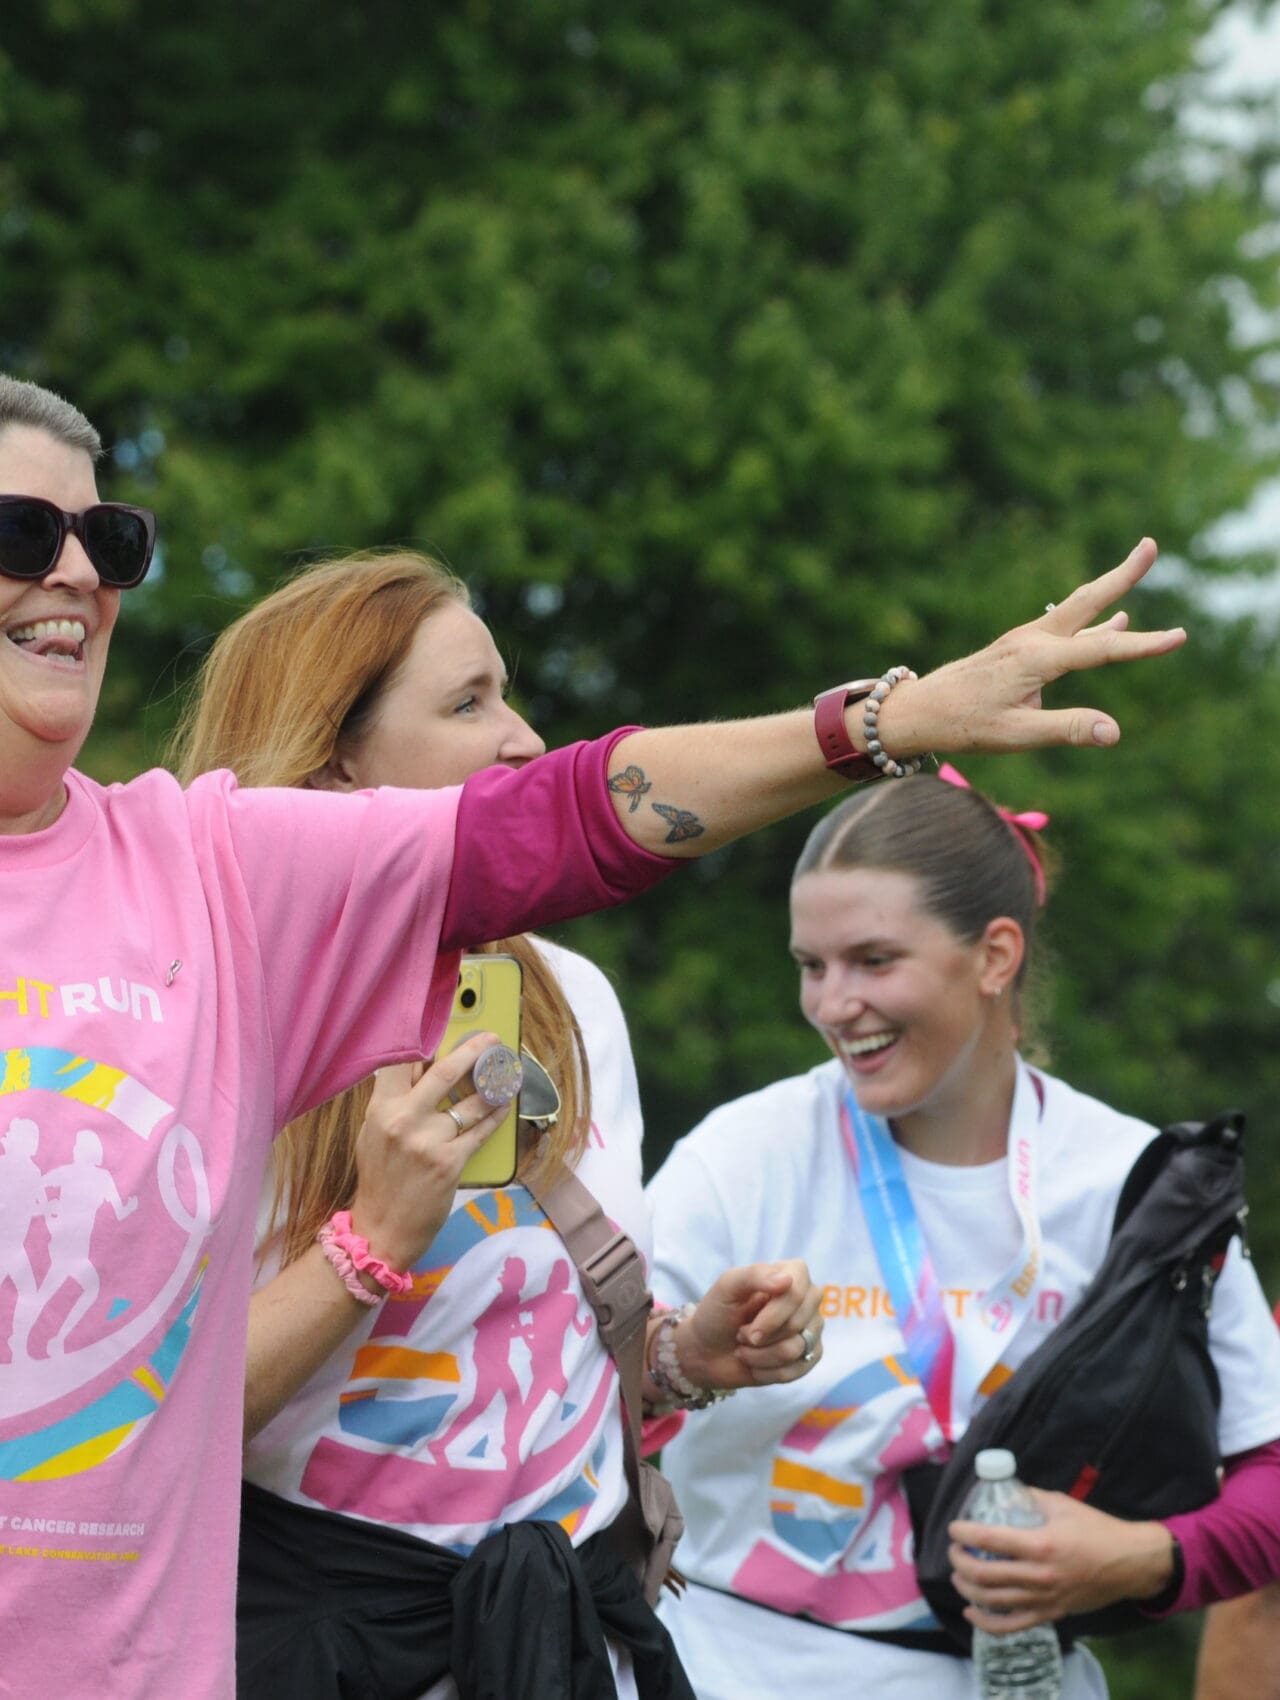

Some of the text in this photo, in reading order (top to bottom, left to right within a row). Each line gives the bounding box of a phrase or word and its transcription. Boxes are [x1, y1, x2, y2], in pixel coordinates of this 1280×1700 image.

[11, 1516, 76, 1534] CANCER
[79, 1522, 145, 1536] RESEARCH
[8, 1545, 39, 1557] LAKE
